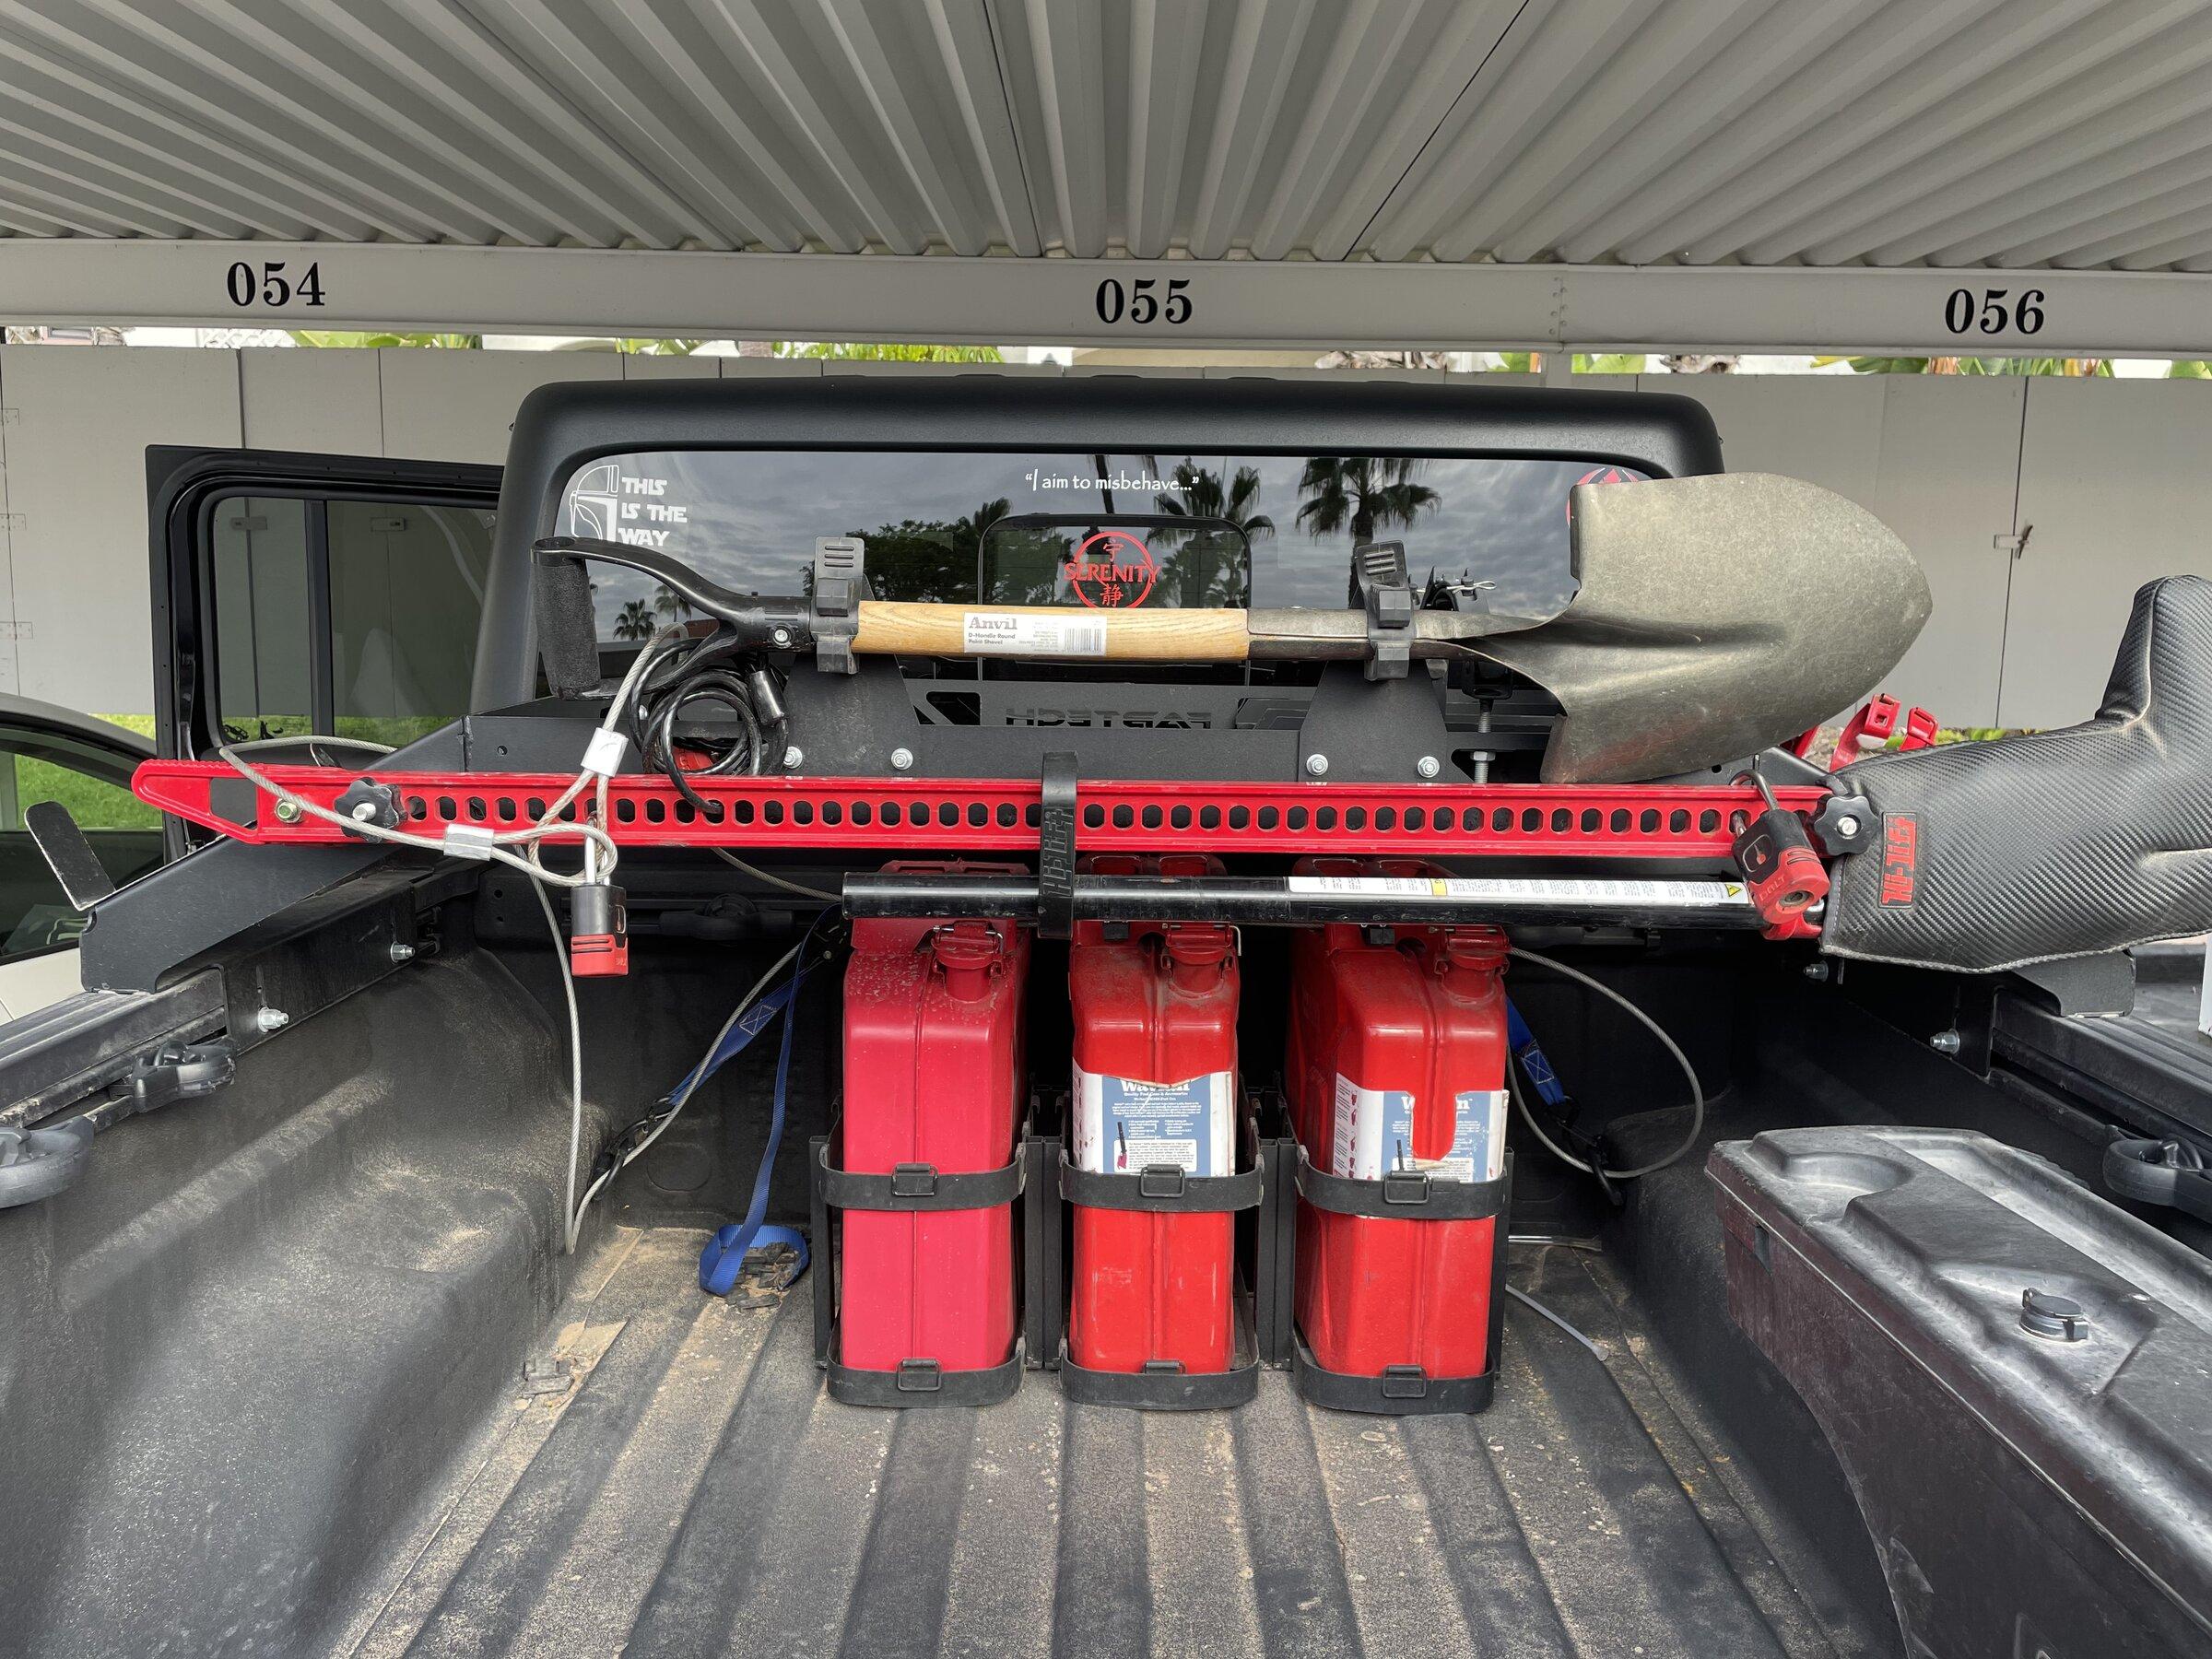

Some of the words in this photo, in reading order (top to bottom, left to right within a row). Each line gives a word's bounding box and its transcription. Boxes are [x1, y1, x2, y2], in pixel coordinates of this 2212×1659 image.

[228, 262, 325, 306] 054
[1097, 279, 1192, 324] 055
[1946, 289, 2044, 334] 056
[621, 477, 667, 496] THIS
[1041, 473, 1068, 489] aim
[1072, 475, 1091, 489] to
[621, 502, 641, 520] IS
[646, 503, 688, 524] THE
[618, 527, 671, 547] WAY
[1064, 559, 1163, 587] SERENITY
[969, 617, 1018, 630] Anvil
